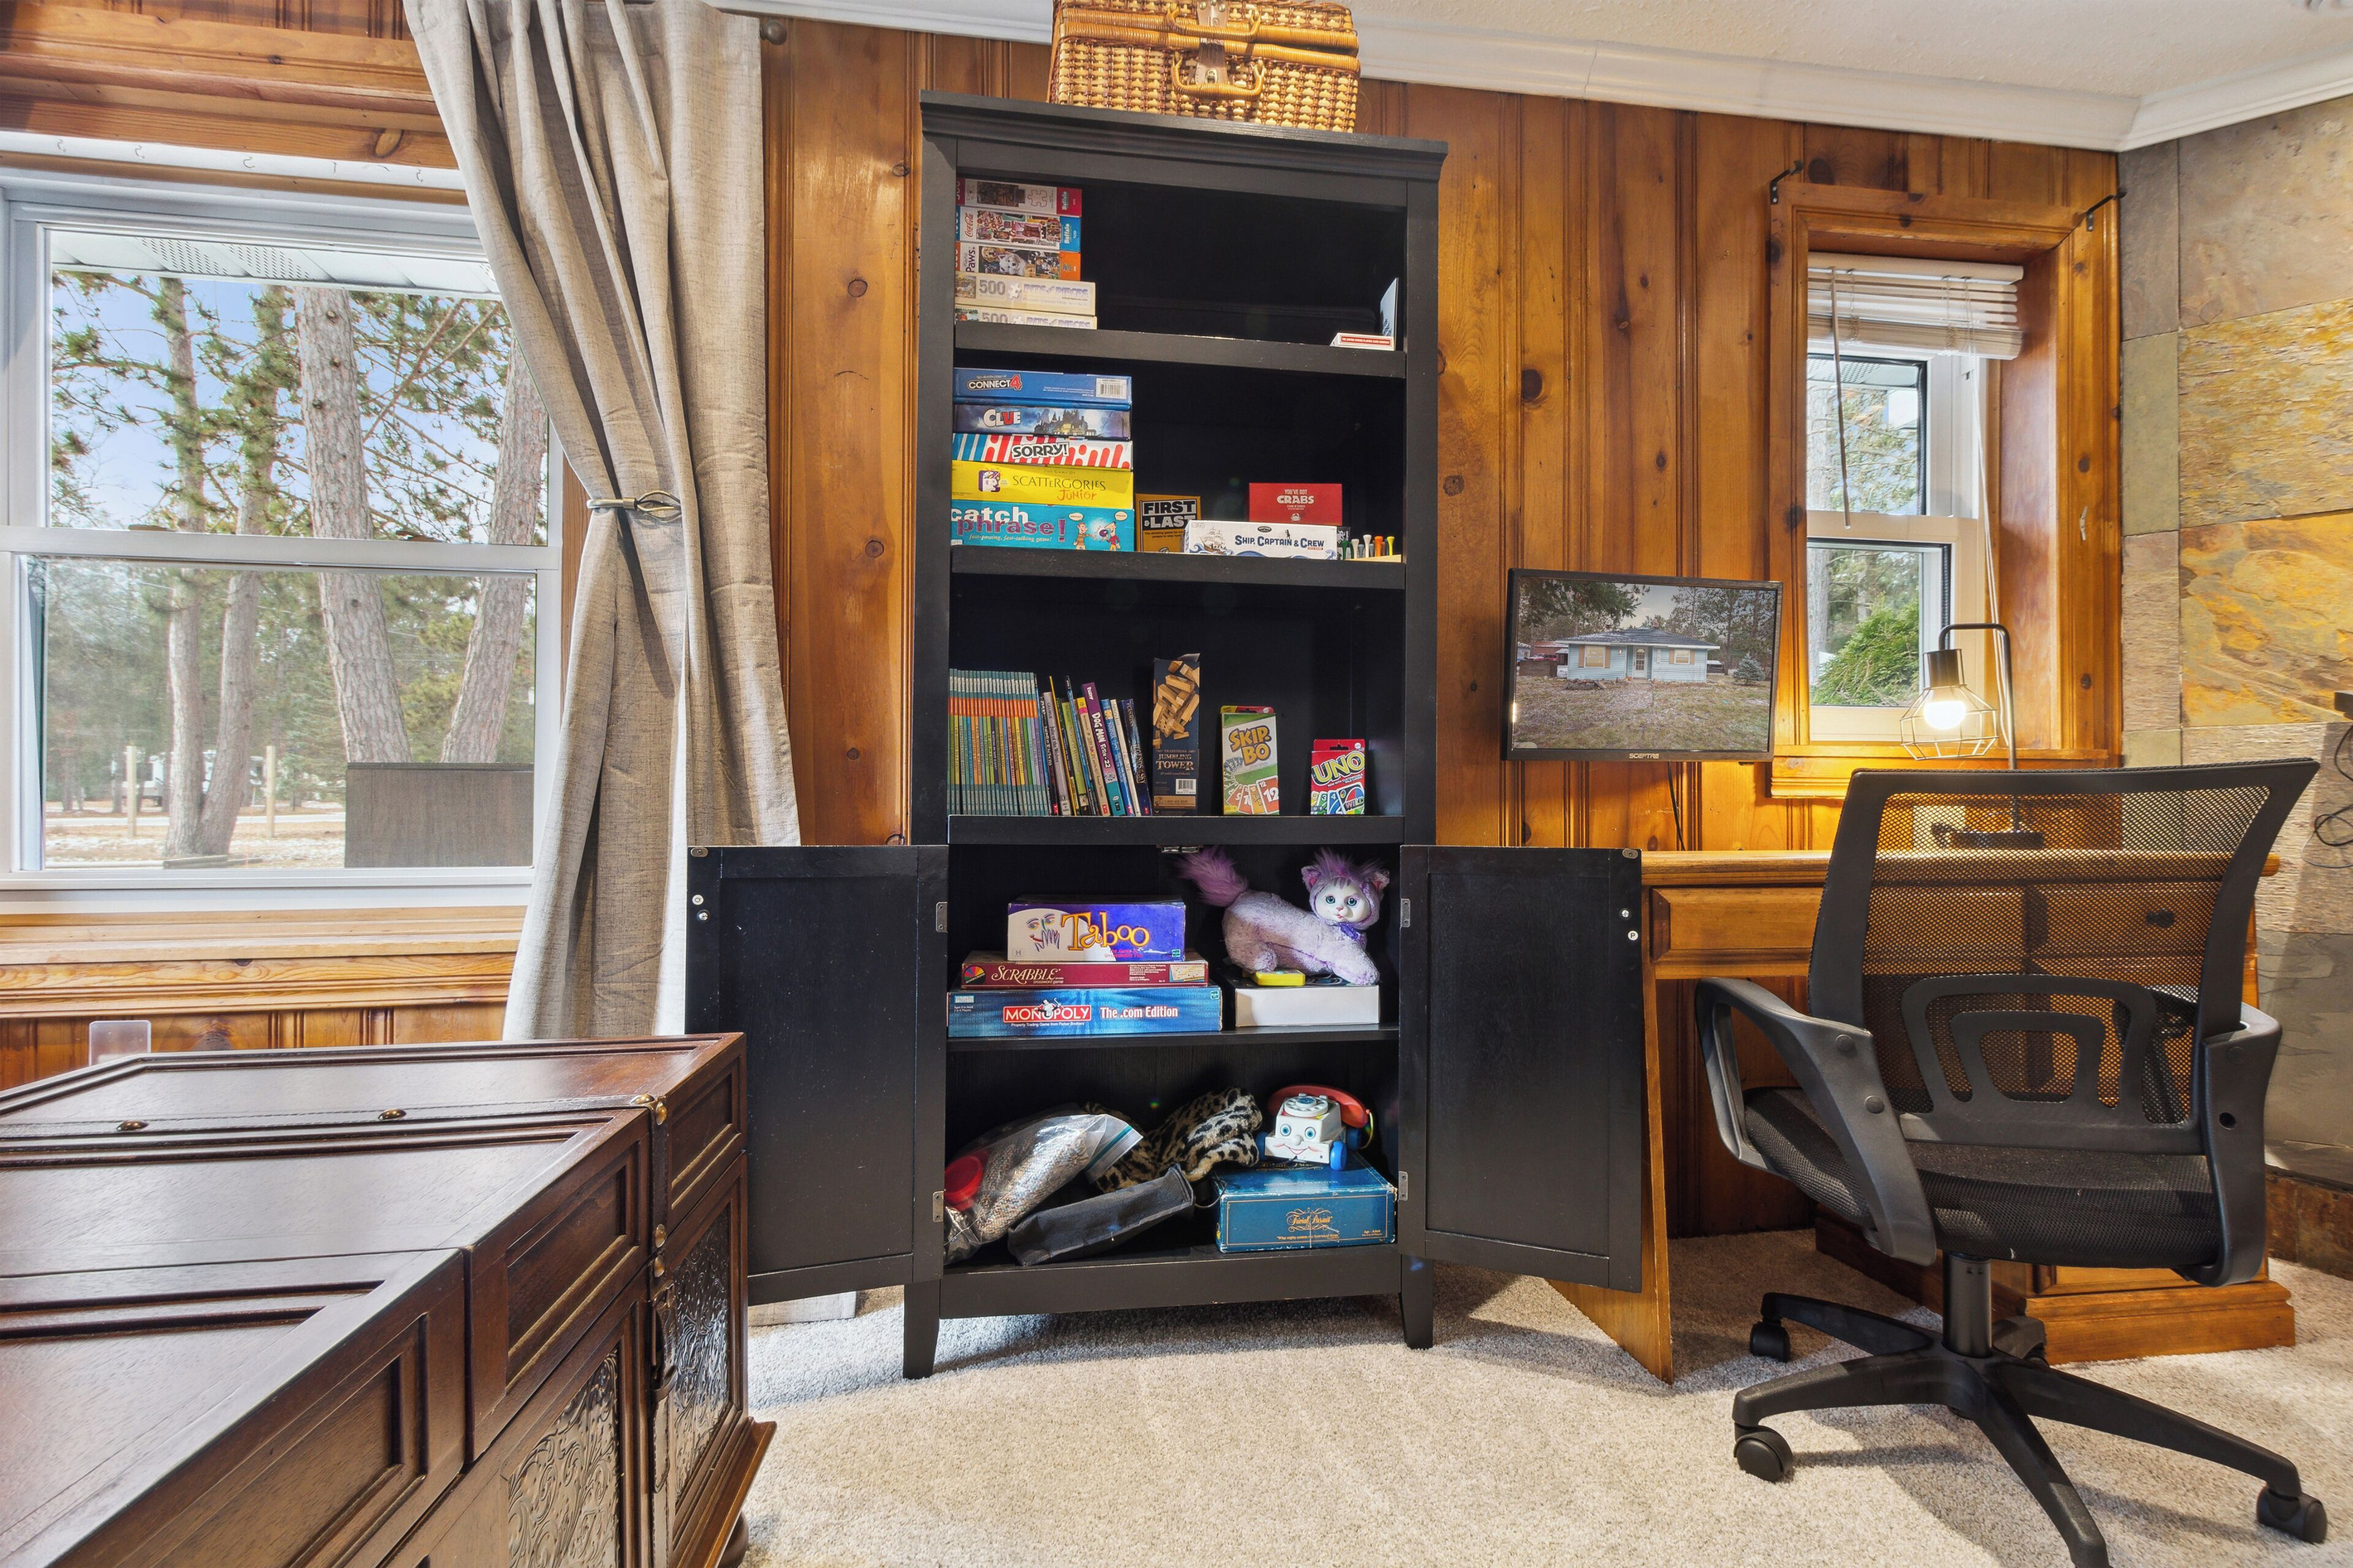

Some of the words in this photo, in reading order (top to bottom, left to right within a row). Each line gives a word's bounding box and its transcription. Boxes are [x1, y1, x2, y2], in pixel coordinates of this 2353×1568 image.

[979, 279, 1006, 296] 500
[982, 312, 1008, 324] 500
[968, 379, 1010, 389] CONNECT
[983, 409, 1021, 427] CLUE
[1012, 442, 1069, 457] SORRY!
[1012, 475, 1106, 491] SCATTERGORIES
[1277, 495, 1315, 504] CRABS
[951, 506, 1029, 524] catch
[1143, 500, 1196, 515] FIRST
[1150, 514, 1196, 528] LAST
[957, 515, 1066, 543] phrase!
[1258, 536, 1292, 547] CAPTAIN
[1300, 538, 1325, 548] CREW
[1091, 712, 1103, 728] DOG
[1095, 728, 1107, 743] MAN
[1242, 743, 1271, 766] BO
[1156, 760, 1195, 770] TOWER
[1312, 750, 1365, 784] UNO
[1138, 773, 1146, 784] SKY
[1263, 787, 1279, 803] 12
[1345, 797, 1365, 809] WILD
[1061, 912, 1150, 951] Taboo
[991, 965, 1059, 985] SCRABBLE
[1005, 1006, 1090, 1020] MONOPOLY
[1100, 1006, 1118, 1019] The
[1119, 1007, 1143, 1018] .com
[1145, 1006, 1178, 1018] Edition
[1292, 1214, 1310, 1225] Trivial
[1311, 1214, 1331, 1224] Pursuit
